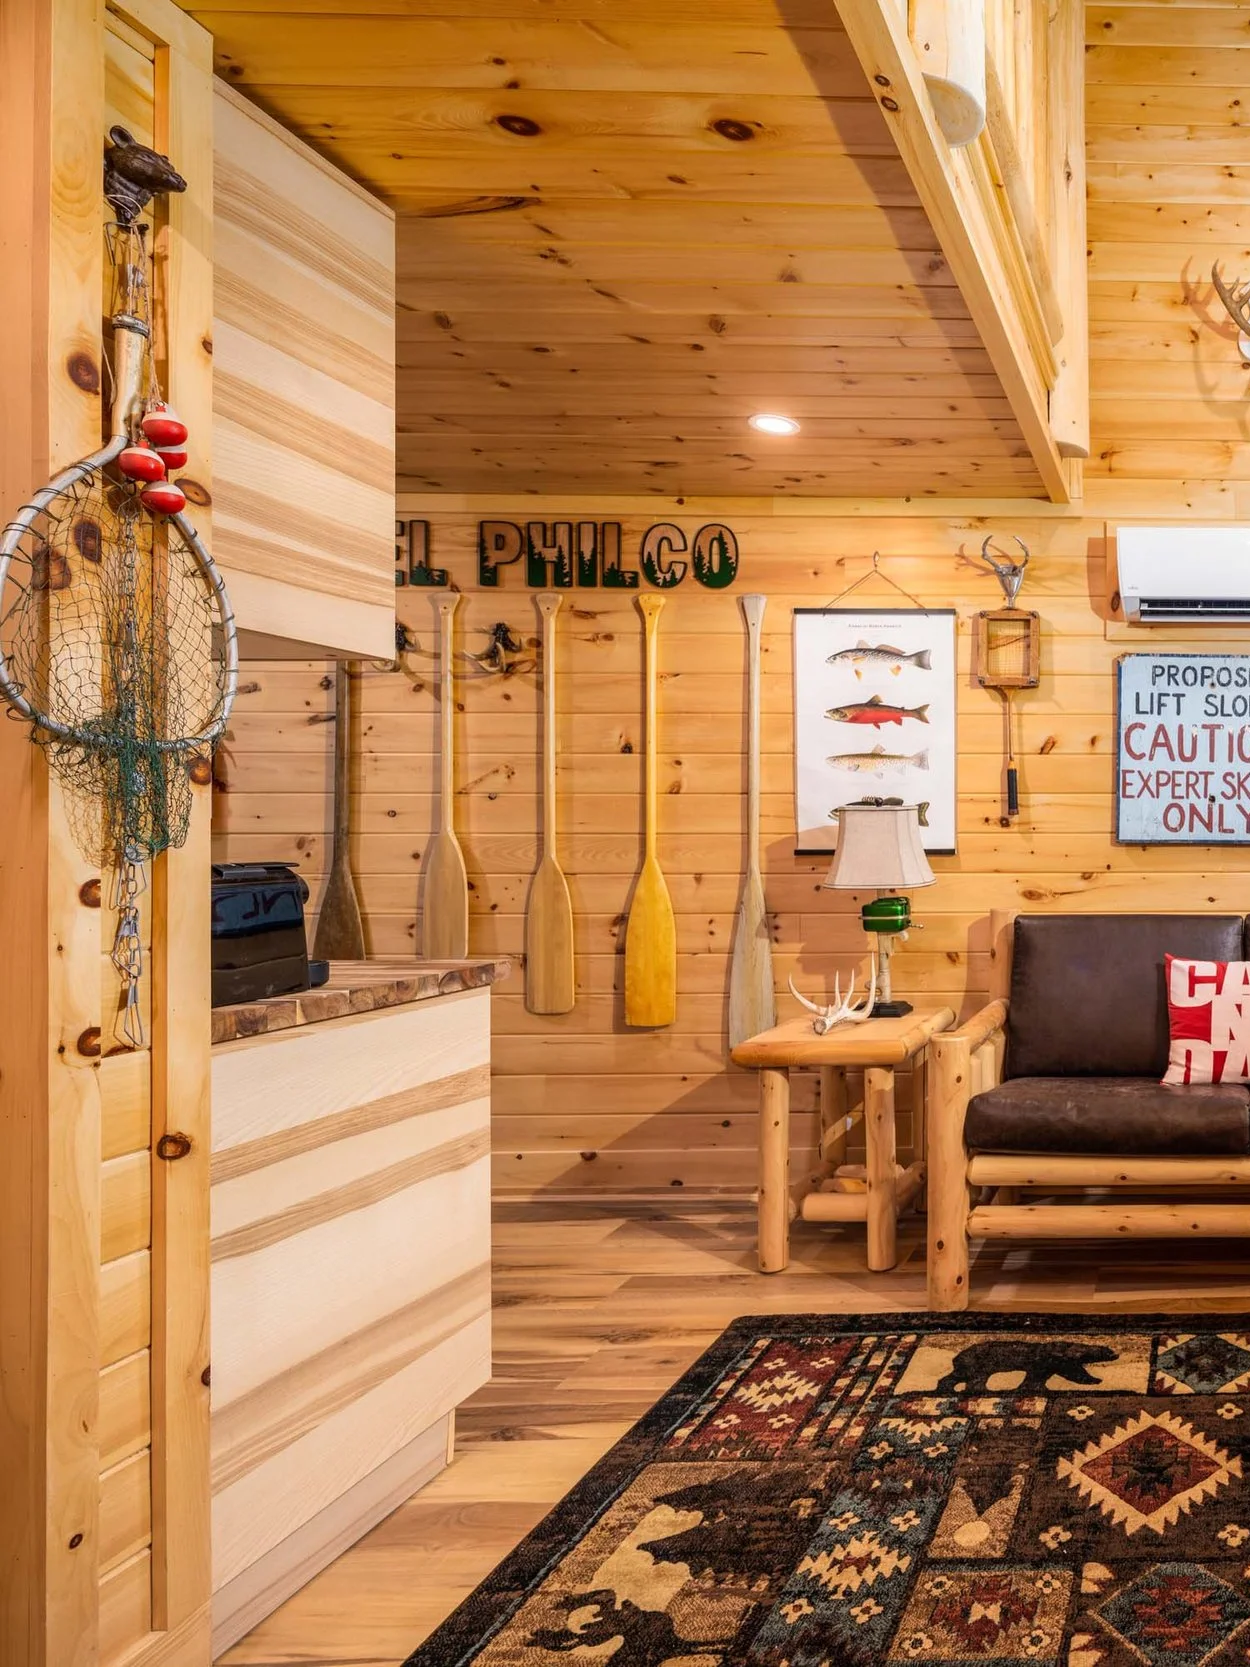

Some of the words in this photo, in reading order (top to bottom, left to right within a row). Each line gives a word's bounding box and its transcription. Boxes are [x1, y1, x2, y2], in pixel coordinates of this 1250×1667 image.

[395, 519, 448, 587] L
[479, 520, 739, 588] PHILCO
[1135, 692, 1186, 716] LIFT
[1121, 769, 1215, 799] EXPERT
